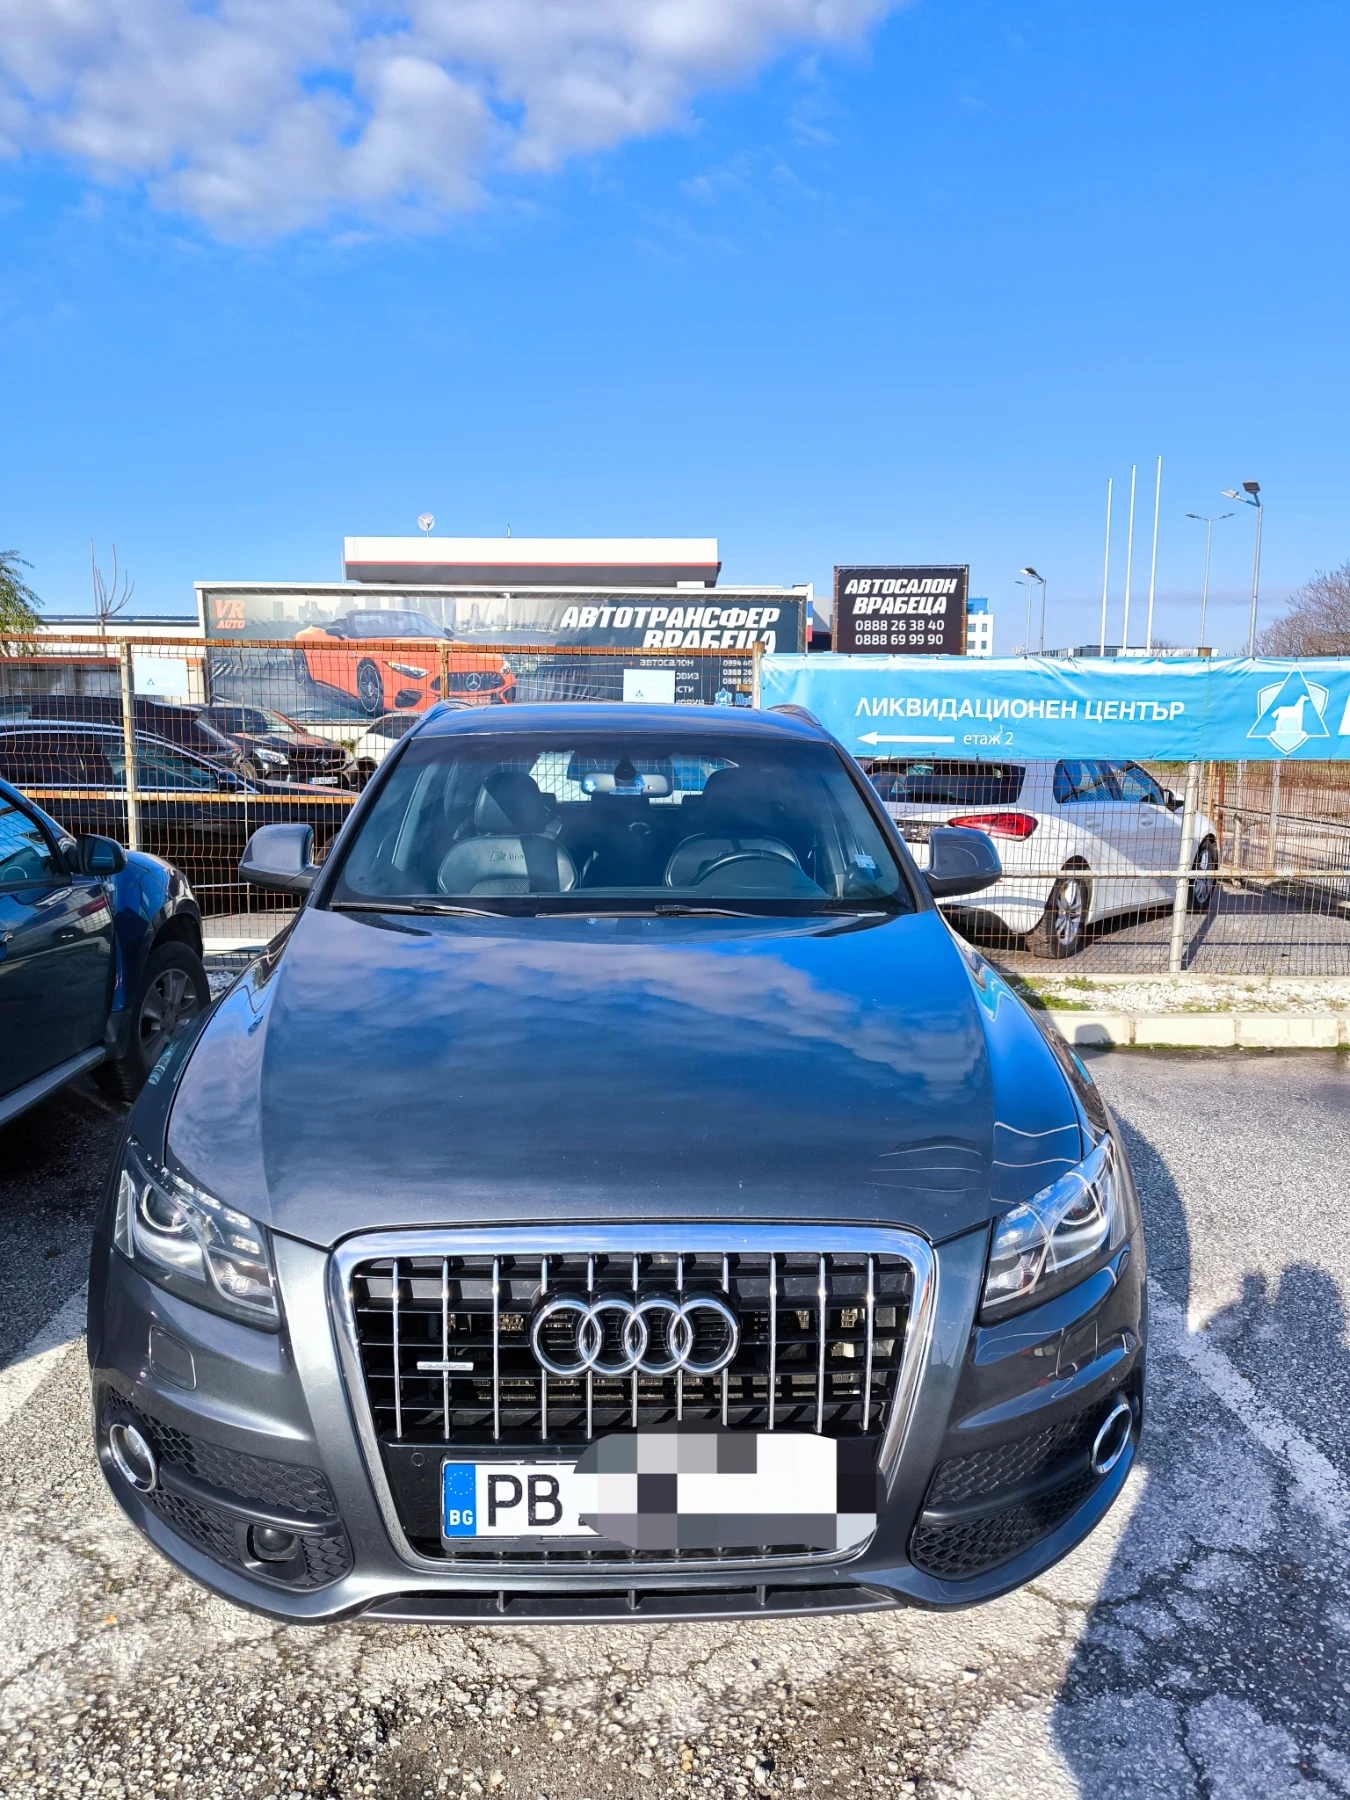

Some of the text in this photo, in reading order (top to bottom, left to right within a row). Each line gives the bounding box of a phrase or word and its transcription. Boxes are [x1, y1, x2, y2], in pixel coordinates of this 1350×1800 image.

[844, 578, 958, 595] АВТОСАЛОН
[214, 599, 246, 619] VR
[852, 596, 947, 615] ВРАБЕЦА
[216, 620, 246, 630] AUTO
[559, 606, 781, 629] АВТОТРАНСФЕР
[855, 620, 945, 631] 0888 26 38 40
[855, 634, 944, 645] 0888 69 99 90
[639, 658, 695, 667] автосалон
[855, 697, 1186, 723] ЛИКВИДАЦИОНЕН ЦЕНТЪР
[963, 731, 1014, 745] етаж 2
[487, 1473, 563, 1527] PB
[449, 1509, 473, 1526] BG
